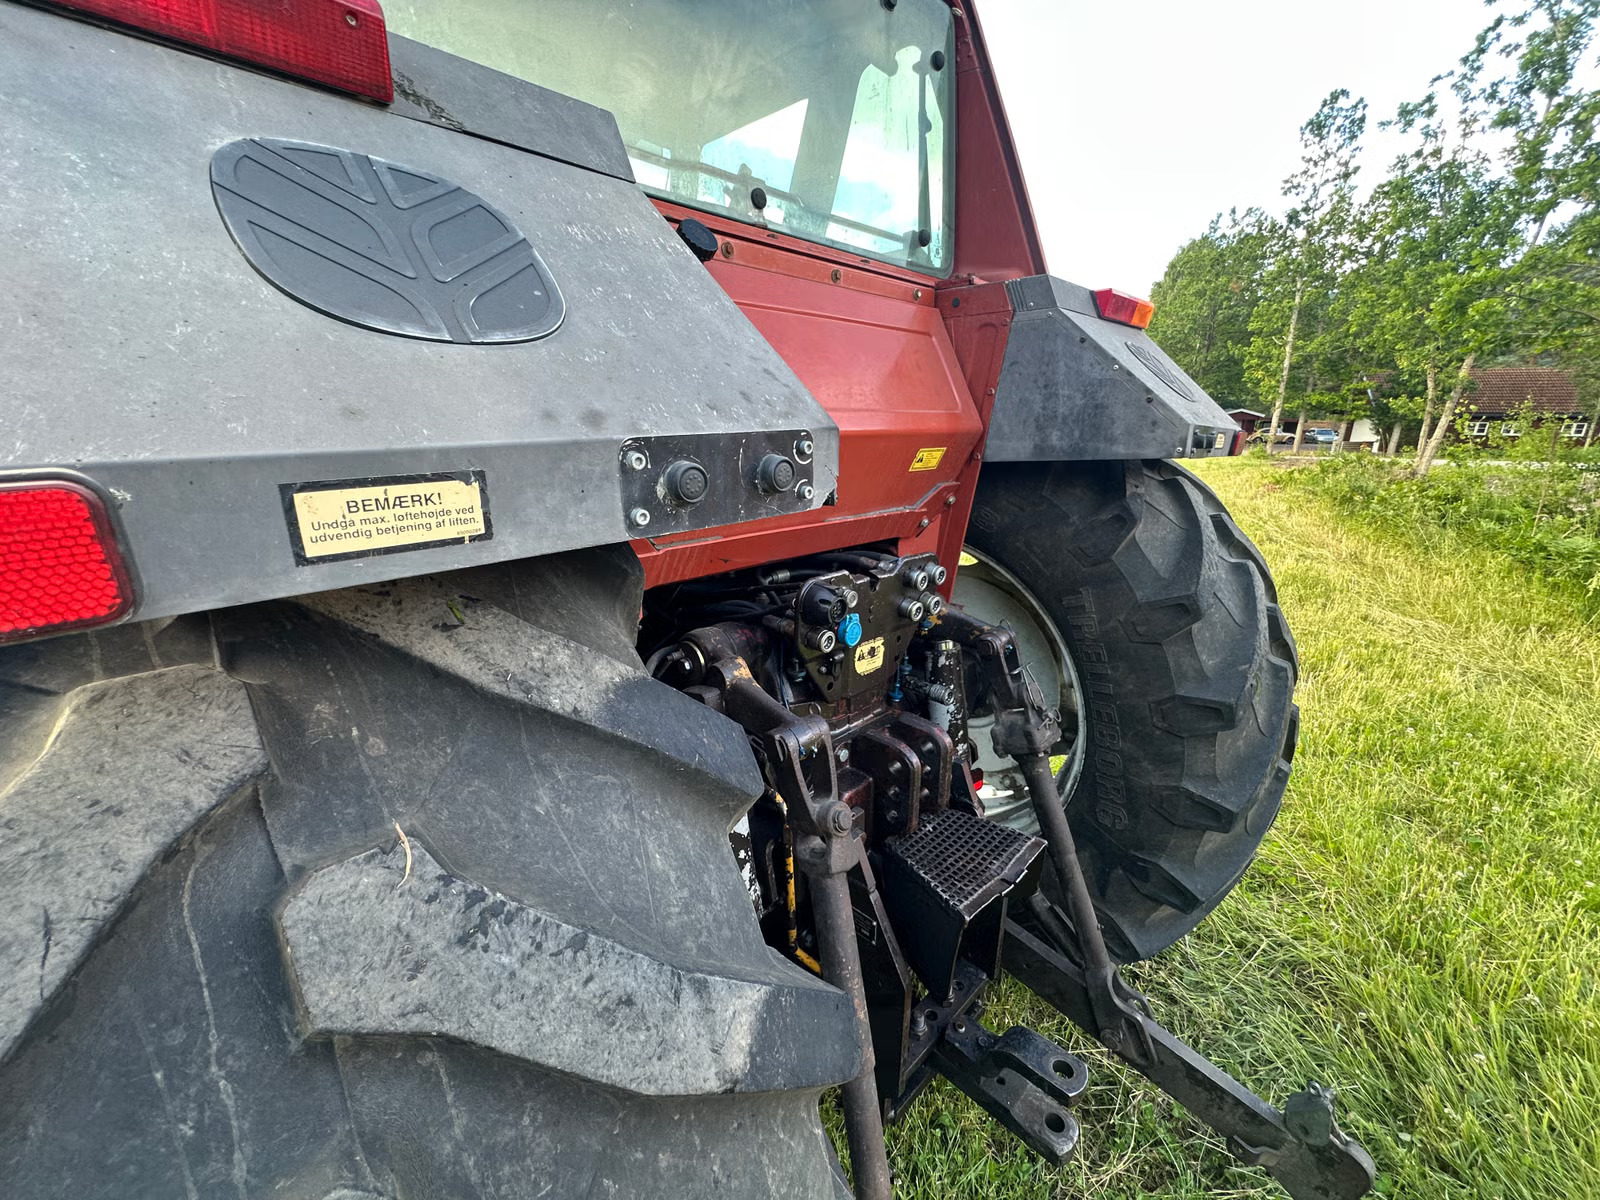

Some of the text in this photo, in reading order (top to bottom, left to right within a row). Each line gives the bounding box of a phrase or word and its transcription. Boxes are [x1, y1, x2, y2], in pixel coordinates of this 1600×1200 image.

[346, 492, 442, 514] BEMÆRK!
[360, 516, 390, 526] max.
[455, 505, 475, 515] ved
[310, 516, 479, 544] udvendig betjening af liften.
[1061, 587, 1128, 831] TRELLEBORG
